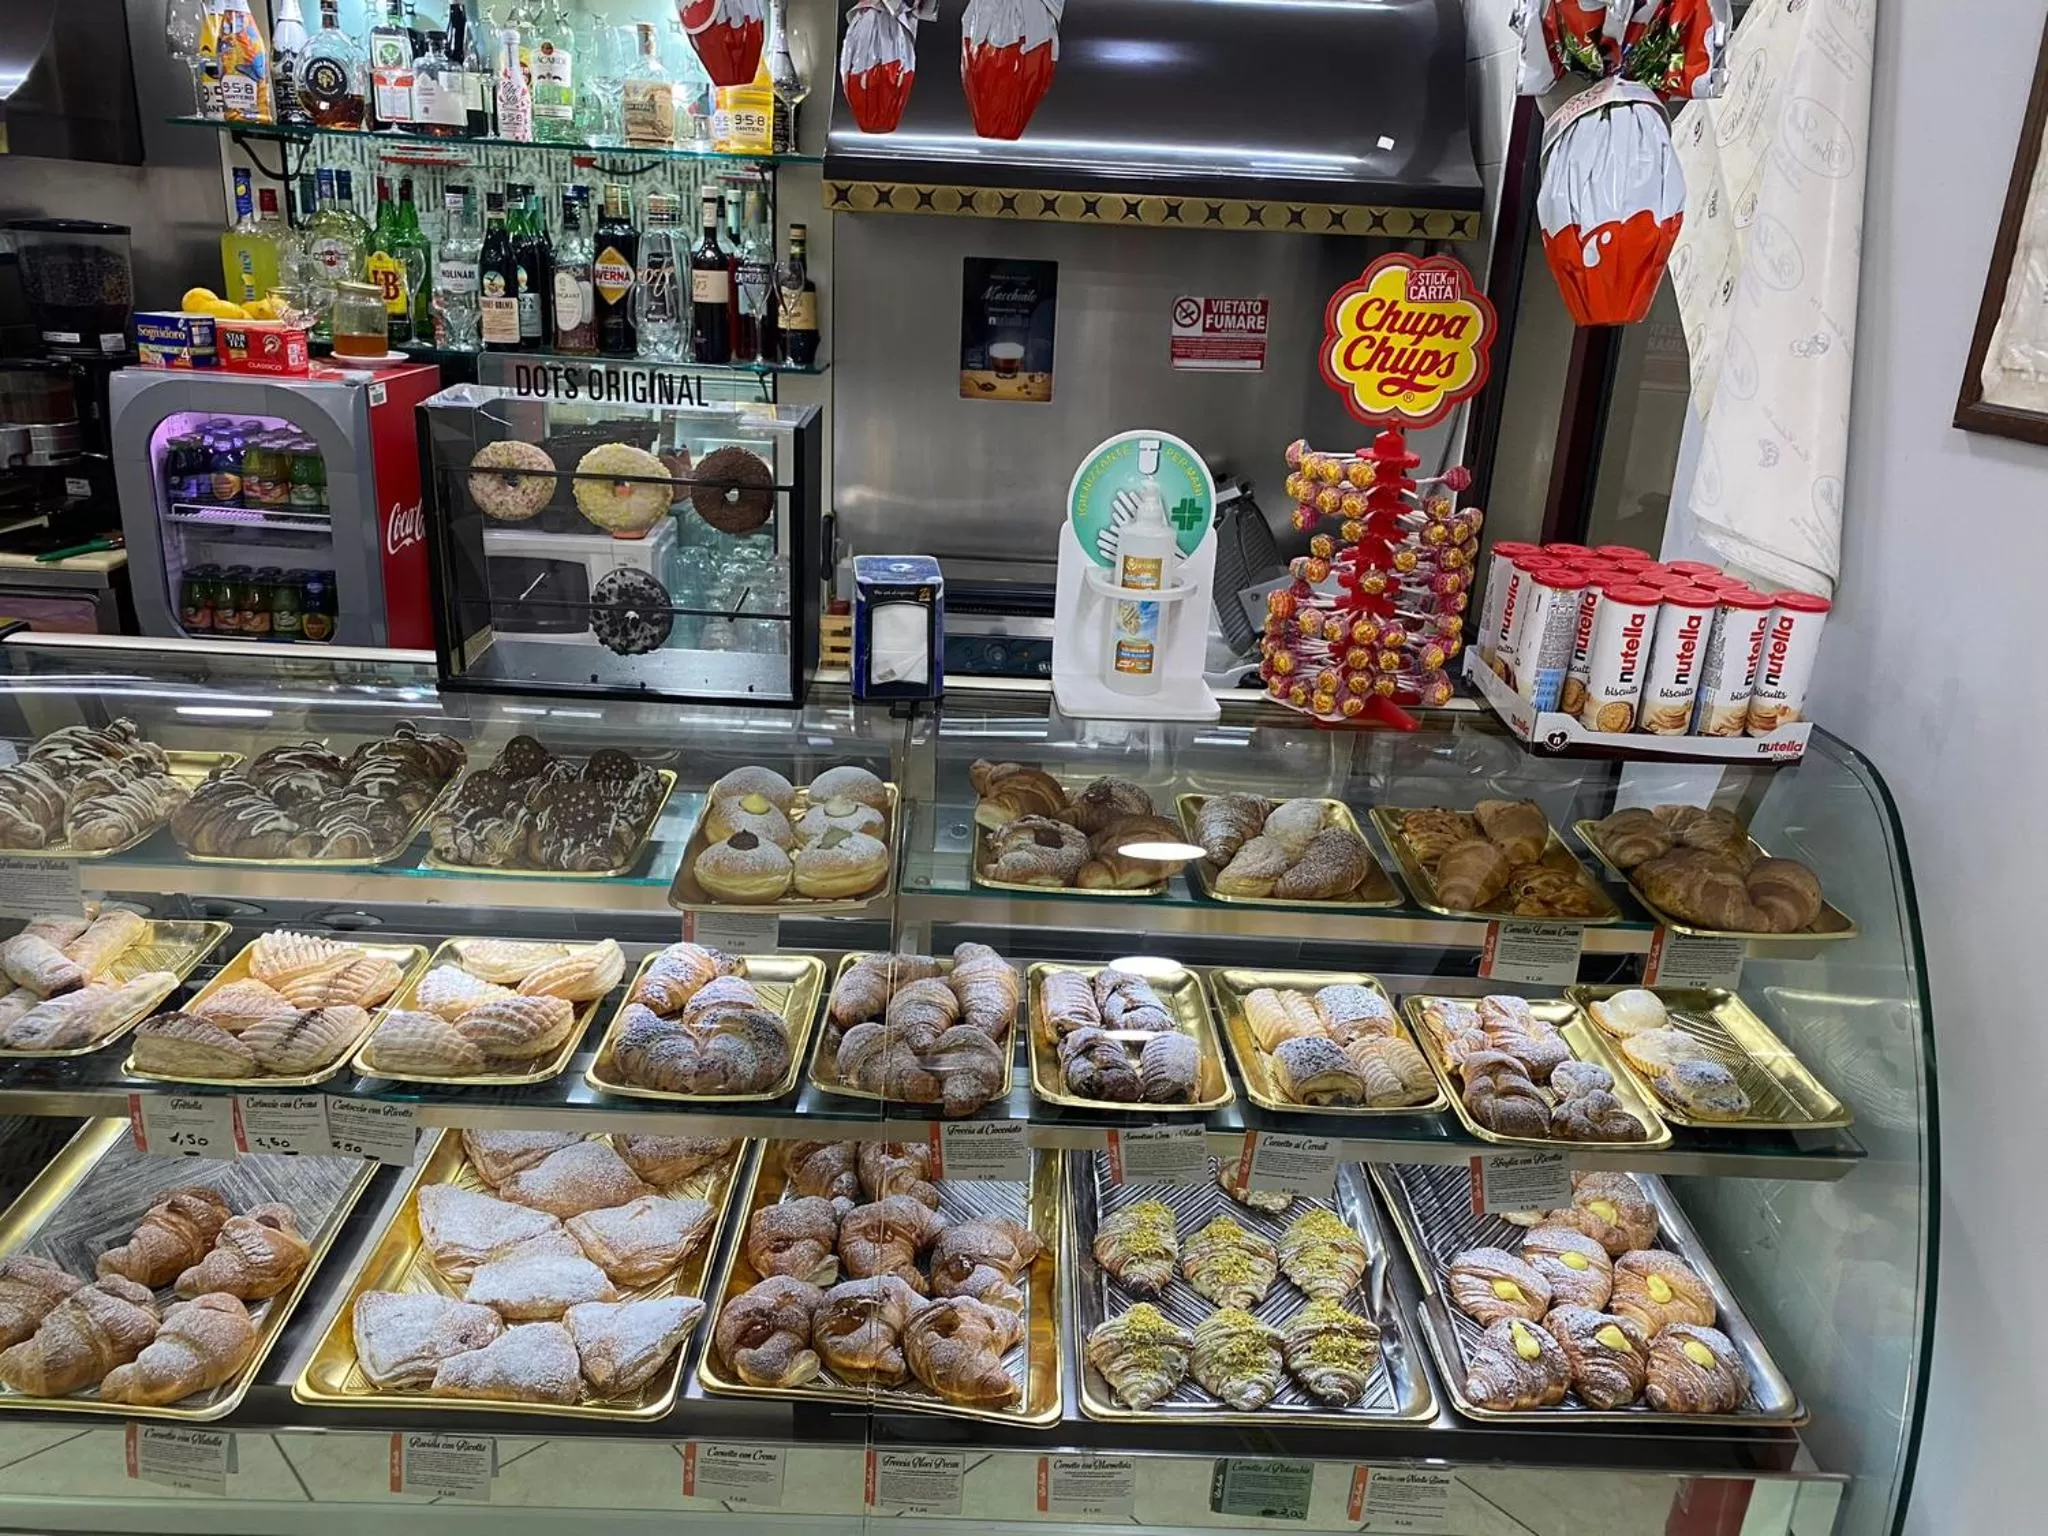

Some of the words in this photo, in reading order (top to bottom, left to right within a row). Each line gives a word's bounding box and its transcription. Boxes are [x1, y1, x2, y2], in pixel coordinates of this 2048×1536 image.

[1418, 273, 1446, 286] STICK
[1409, 287, 1453, 300] CARTA
[1211, 300, 1261, 313] VIETATO
[1205, 314, 1265, 329] FUMARE
[1355, 298, 1471, 346] Chupa
[226, 332, 246, 342] STAR
[230, 340, 245, 349] TEA
[248, 361, 283, 372] CLASSICO
[1343, 335, 1459, 390] Chups
[515, 365, 578, 399] DOTS
[588, 369, 710, 407] ORIGINAL
[1501, 574, 1520, 641] nutella
[1574, 592, 1599, 661] nutella
[1619, 613, 1646, 683] nutella
[1674, 615, 1702, 684] nutella
[1744, 617, 1768, 686] nutella
[1765, 616, 1794, 686] nutella
[1604, 686, 1638, 696] biscuits
[1660, 687, 1693, 697] biscuits
[1758, 742, 1804, 753] nutella
[293, 1097, 317, 1109] Crema
[383, 1105, 413, 1118] Ricotta
[985, 1123, 1022, 1135] Cioccolato
[1263, 1135, 1293, 1148] Cornetto
[1533, 1152, 1563, 1164] Ricotta
[707, 1446, 738, 1457] Cornetto
[753, 1449, 777, 1460] Crema
[882, 1454, 911, 1467] Treccia
[1054, 1460, 1080, 1469] Cornetto
[1232, 1460, 1262, 1472] Cornetto
[1272, 1463, 1310, 1474] Pistacchio
